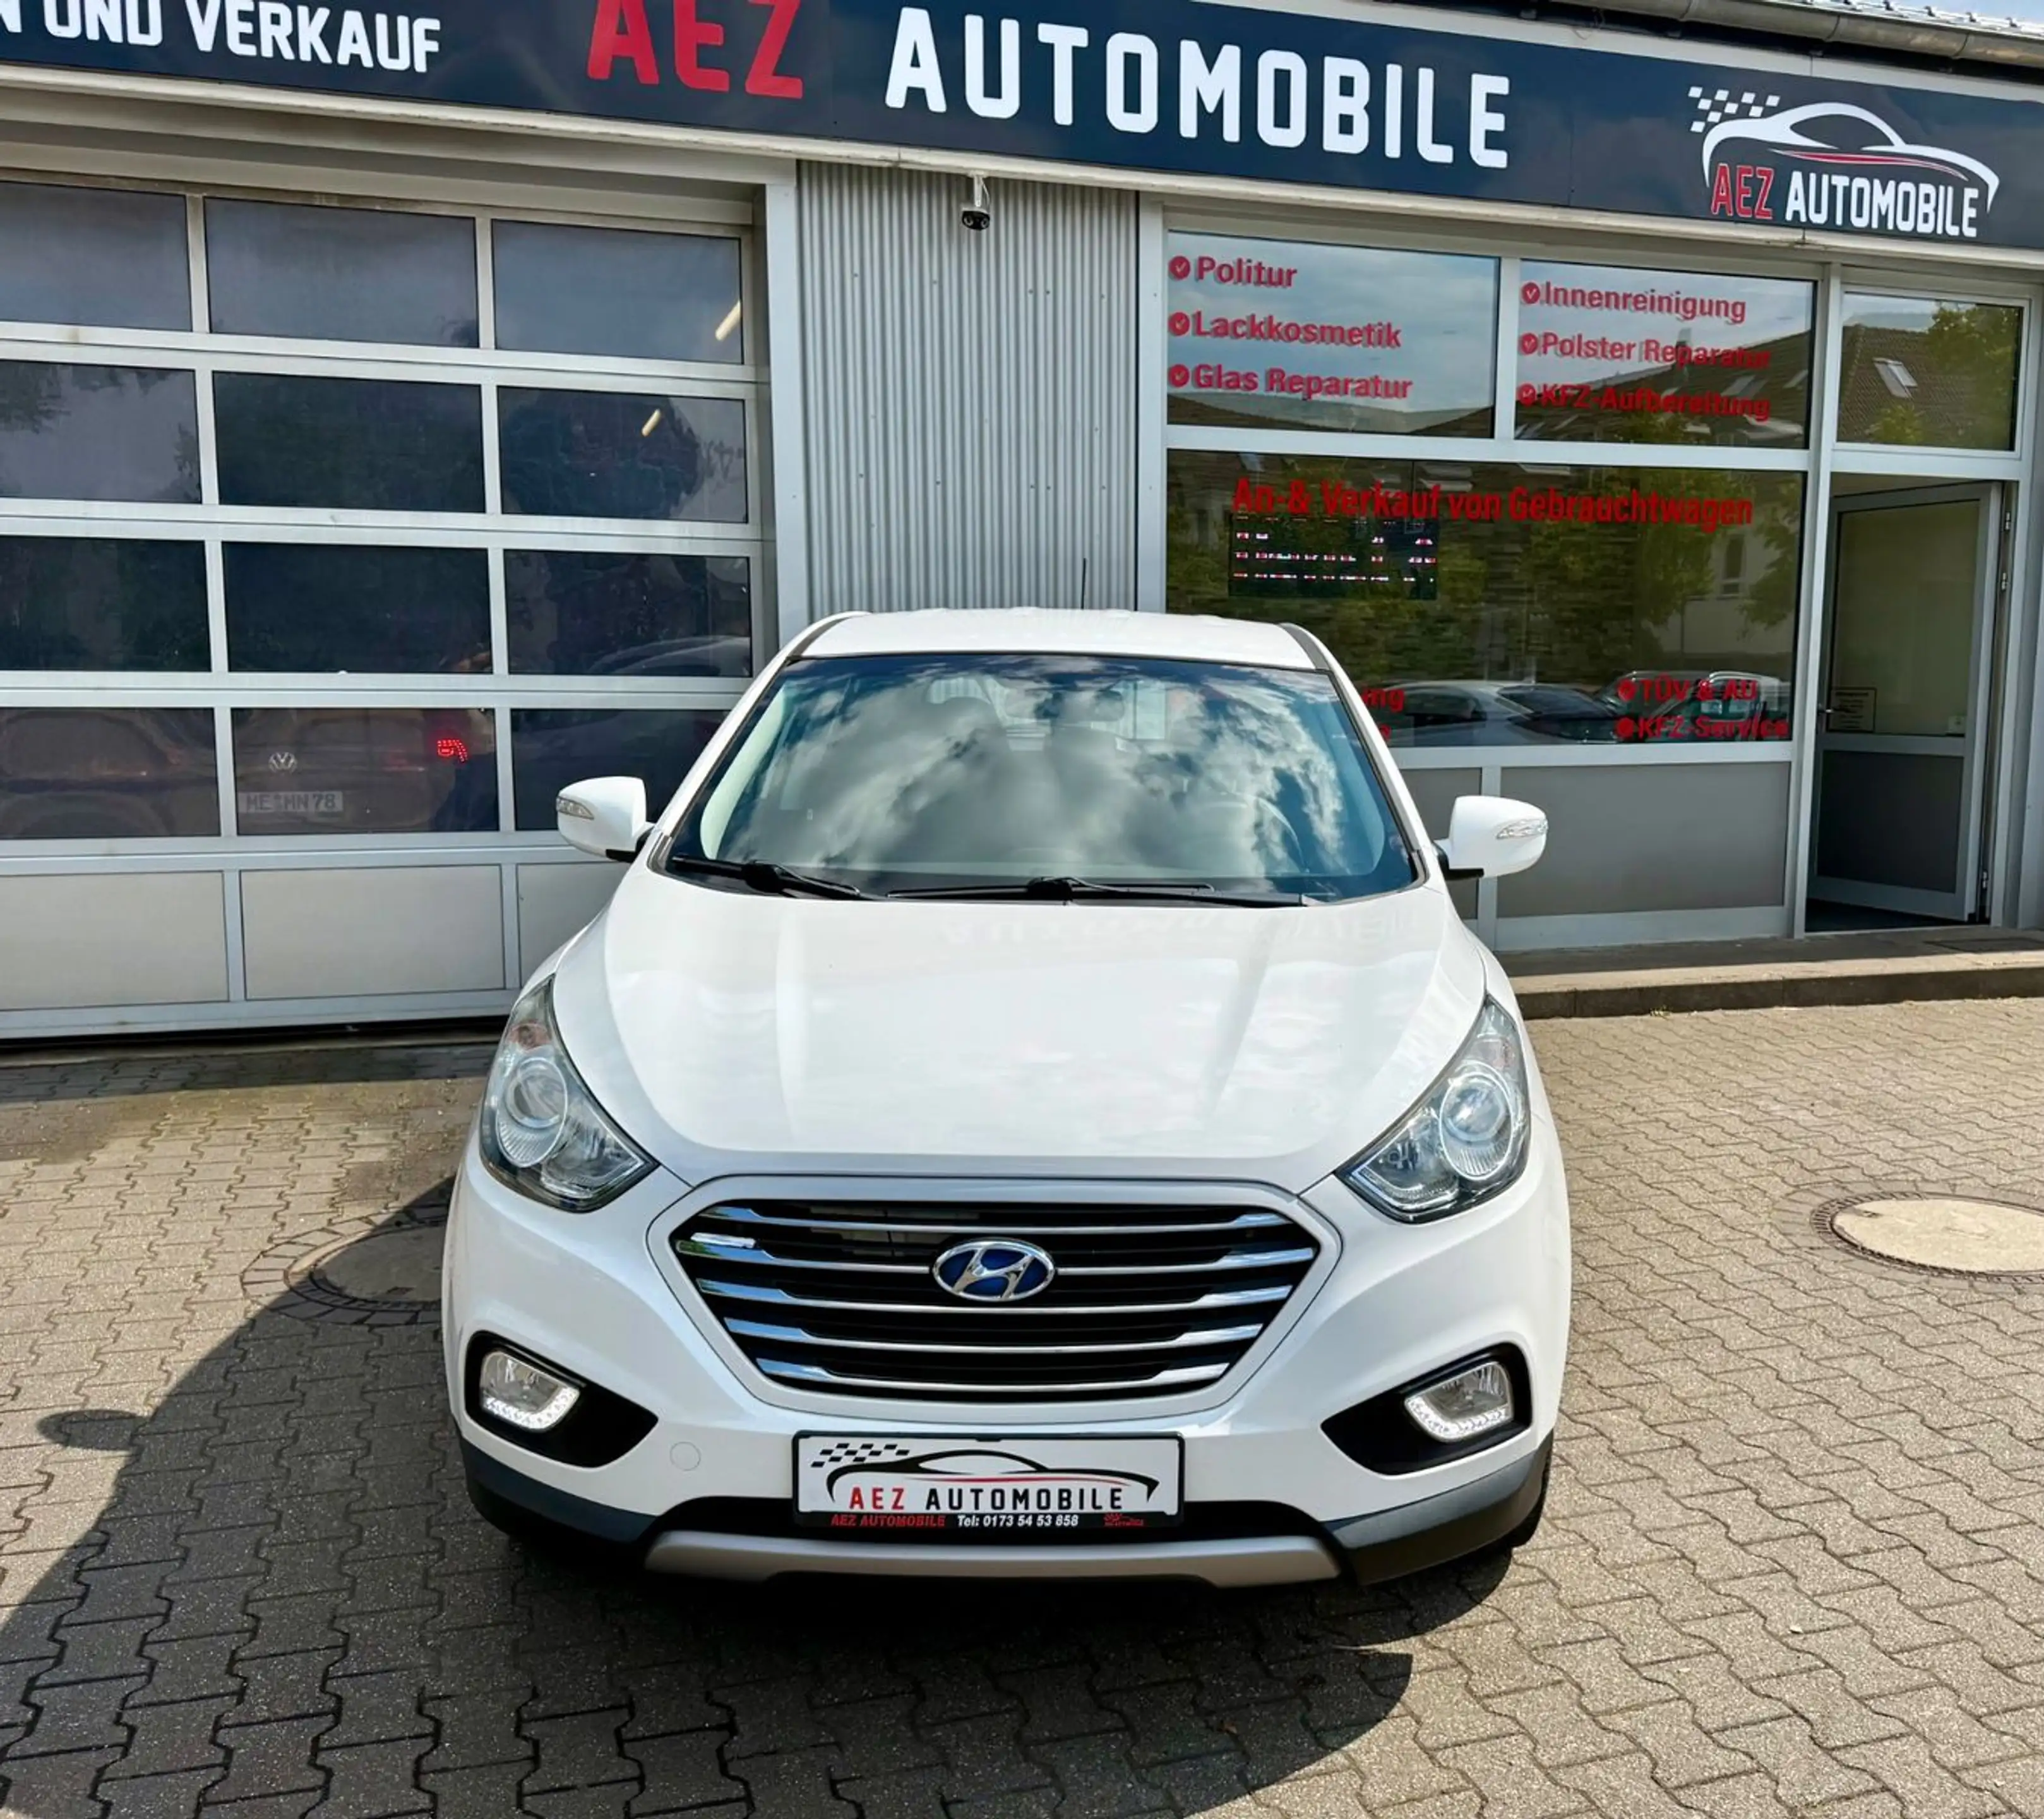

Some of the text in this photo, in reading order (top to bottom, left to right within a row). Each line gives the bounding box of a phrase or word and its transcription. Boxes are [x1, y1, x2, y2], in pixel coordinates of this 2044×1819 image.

[43, 0, 163, 46] UND
[186, 0, 441, 73] VERKAUF
[587, 0, 1510, 169] AEZ AUTOMOBILE
[1711, 163, 1979, 238] AEZ AUTOMOBILE
[1197, 256, 1298, 287] Politur
[1545, 281, 1747, 323] Innenreinigung
[1193, 310, 1402, 348] Lackkosmetik
[1542, 332, 1771, 369] Polster Reparatur
[1193, 363, 1413, 400] Glas Reparatur
[1541, 383, 1771, 421] KFZ-Aufbereitung
[1320, 479, 1441, 520] Verkauf
[1448, 493, 1502, 522] von
[1509, 486, 1754, 533] Gebrauchtwagen
[1638, 715, 1790, 738] KFZ-Service
[313, 793, 337, 810] 78
[849, 1487, 1123, 1510] AEZ AUTOMOBILE
[830, 1514, 1079, 1527] AEZ AUTOMOBILE Tel: 0173 54 53 858
